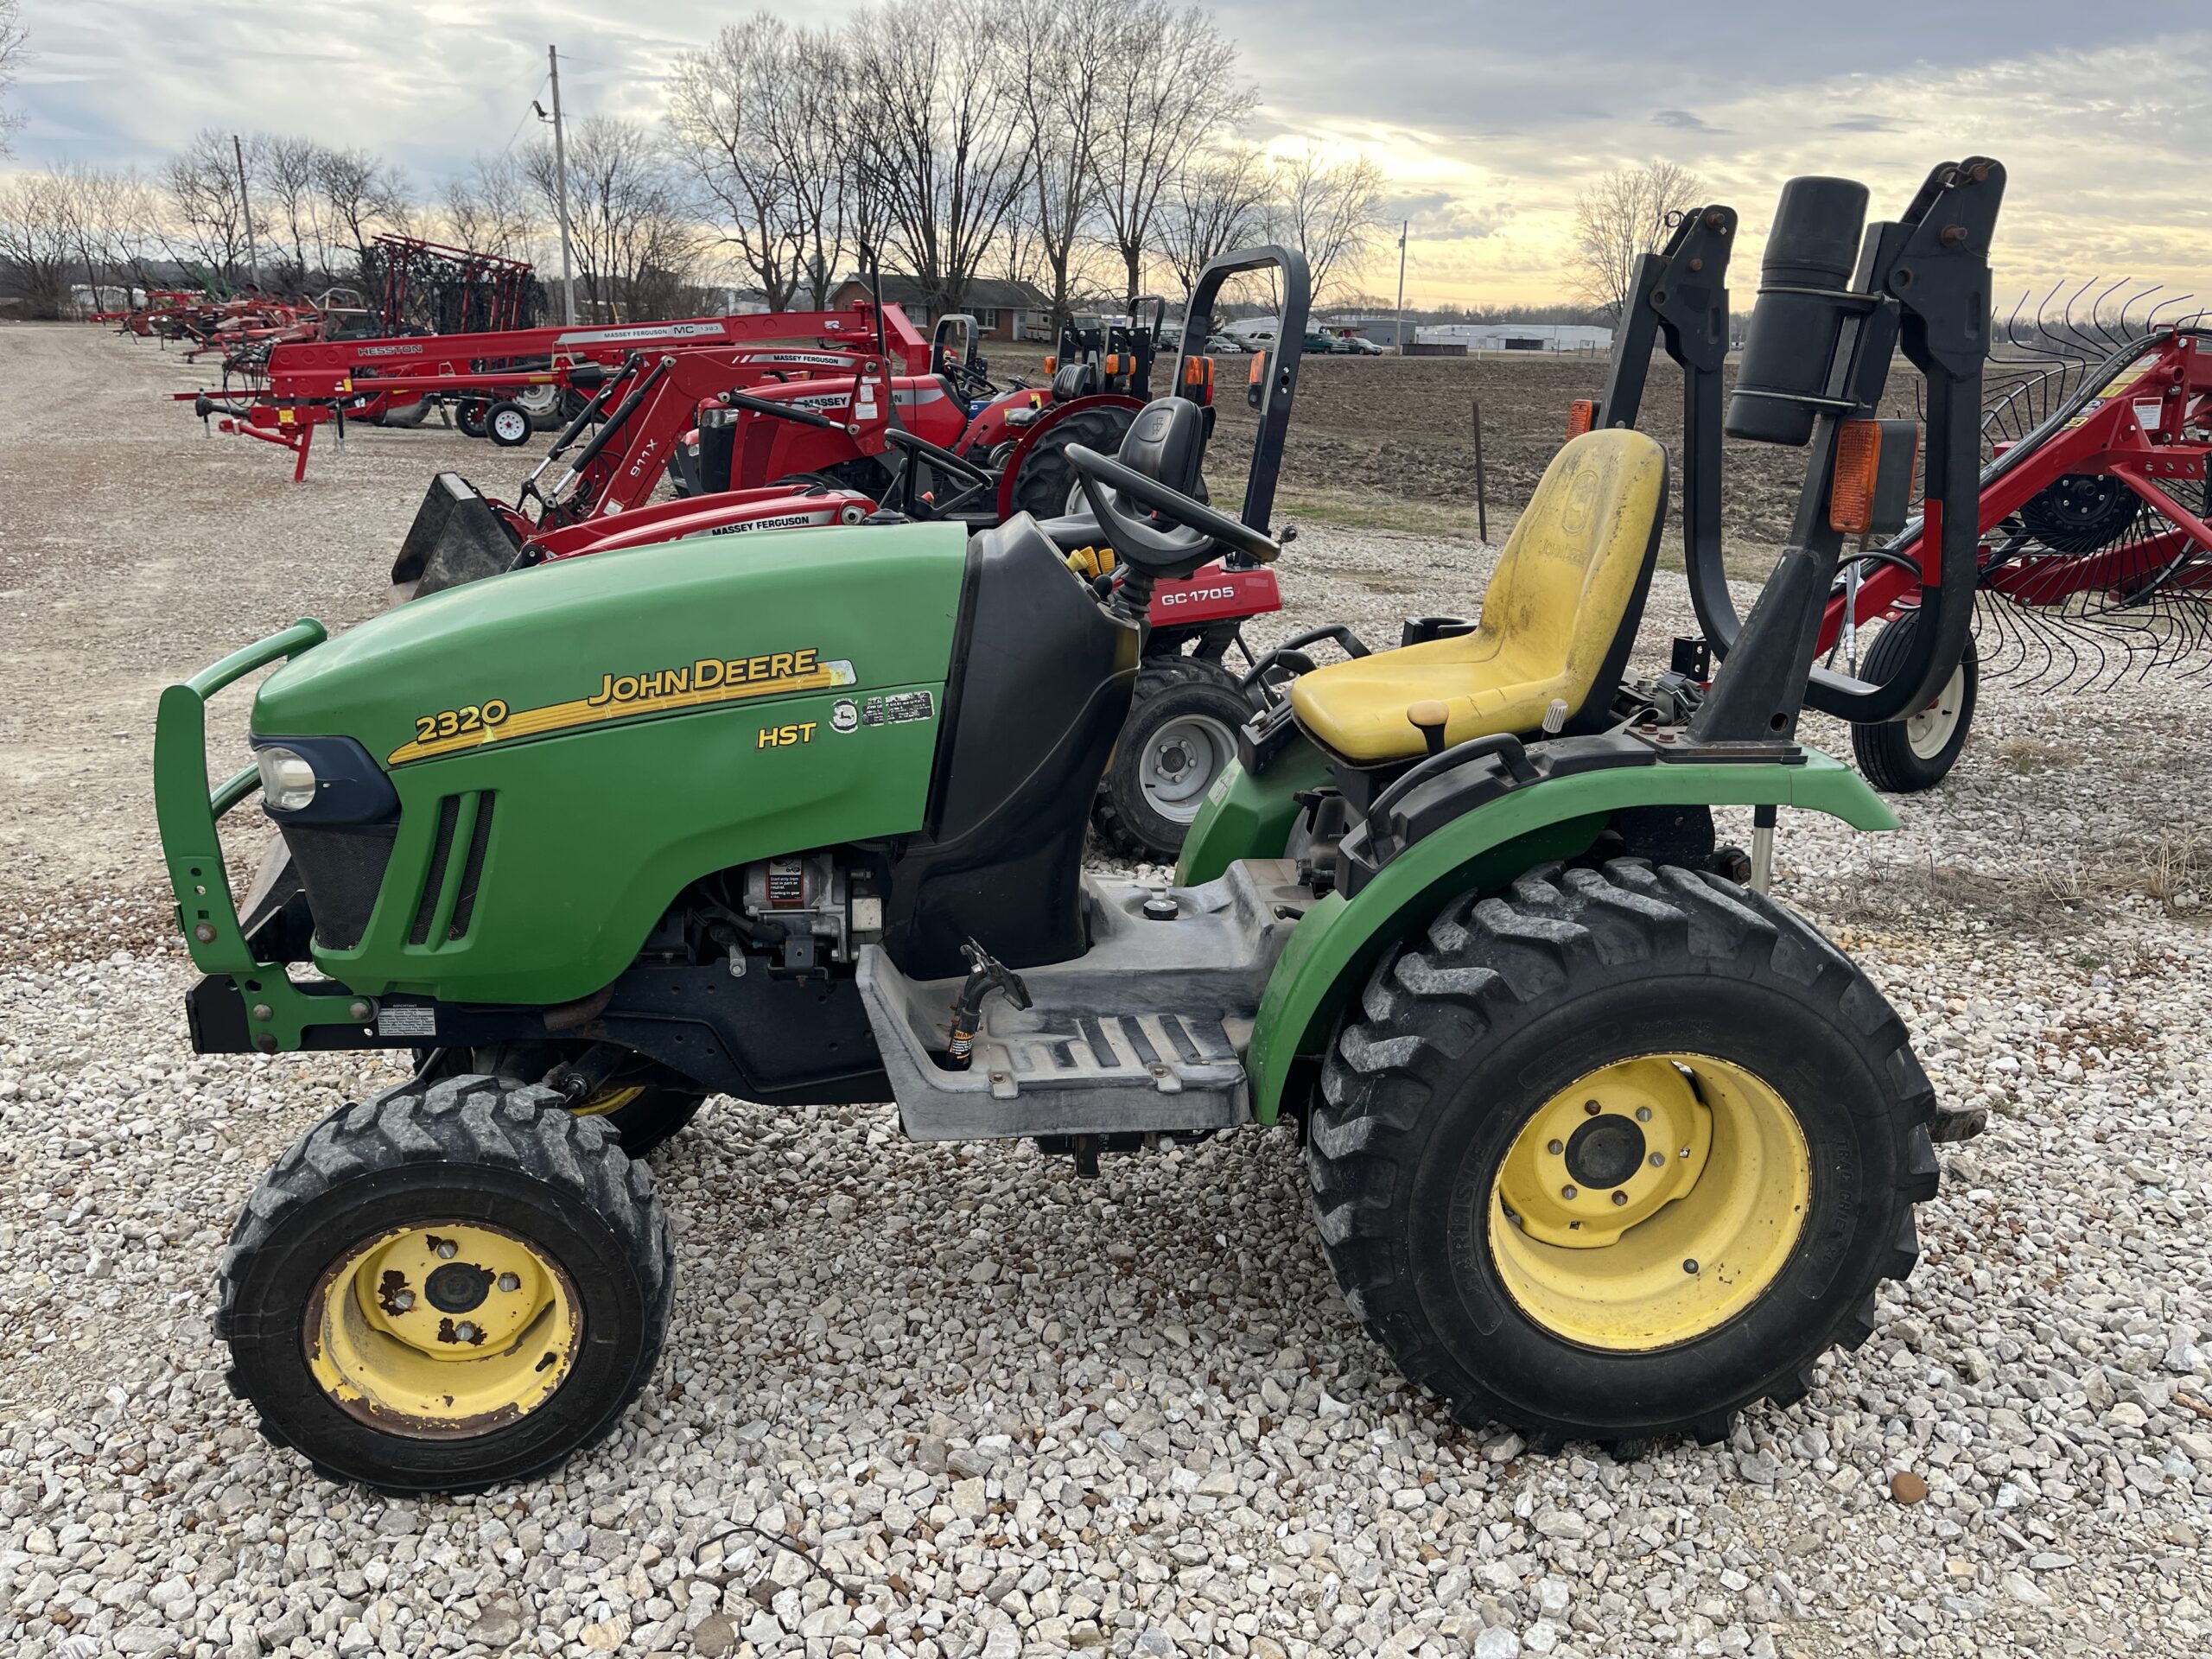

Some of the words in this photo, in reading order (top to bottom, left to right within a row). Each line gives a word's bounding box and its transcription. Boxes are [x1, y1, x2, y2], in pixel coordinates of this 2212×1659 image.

[673, 326, 694, 334] MC
[358, 345, 423, 356] HESSTON
[803, 355, 839, 365] FERGUSON
[804, 397, 847, 408] MASSEY
[630, 438, 658, 478] 911X
[712, 523, 753, 536] MASSEY
[756, 516, 810, 529] FERGUSON
[1161, 593, 1187, 606] GC
[1189, 586, 1234, 601] 1705
[588, 667, 690, 706] JOHN
[691, 648, 818, 690] DEERE
[416, 699, 508, 743] 2320
[757, 722, 817, 749] HST
